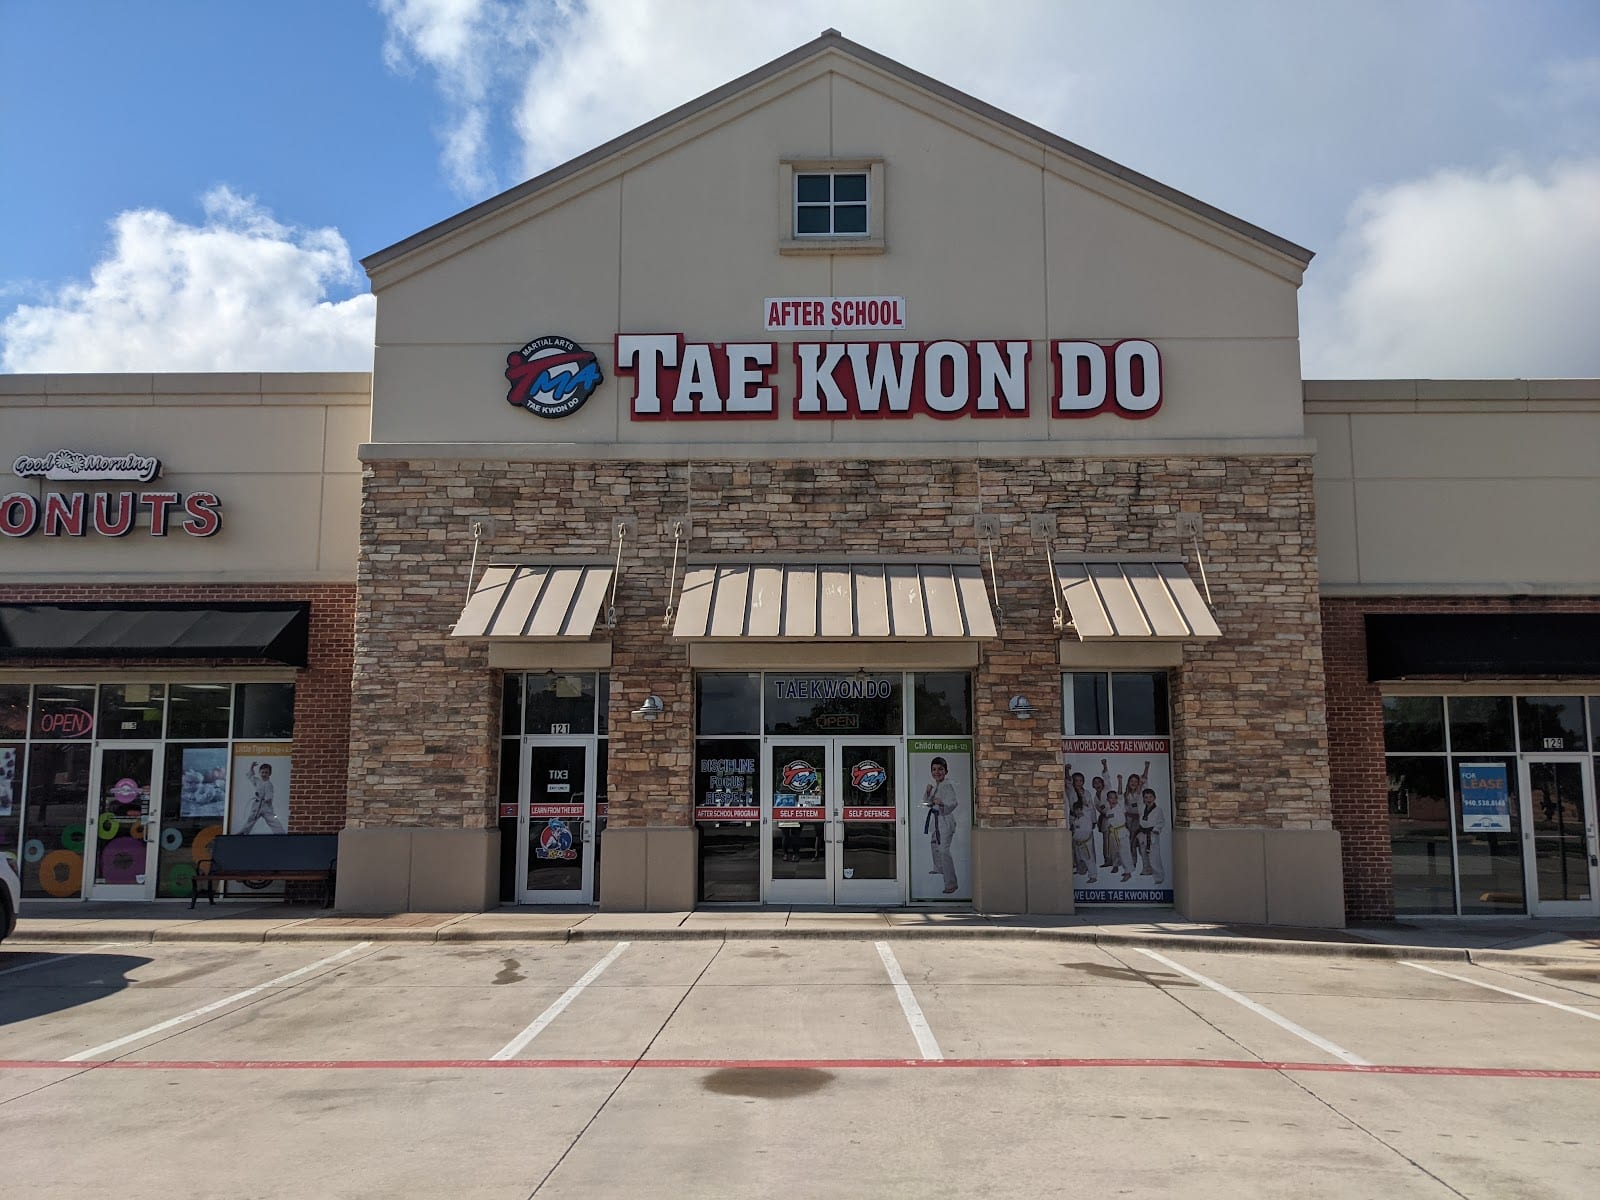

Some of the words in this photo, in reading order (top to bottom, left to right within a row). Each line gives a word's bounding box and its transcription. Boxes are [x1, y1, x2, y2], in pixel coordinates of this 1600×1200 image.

[768, 301, 825, 327] AFTER
[831, 300, 903, 326] SCHOOL
[522, 339, 554, 357] MARTIAL
[554, 339, 575, 351] ARTS
[616, 334, 775, 414] TAE
[796, 340, 1030, 414] KWON
[1056, 339, 1161, 413] DO
[527, 399, 542, 411] TAE
[541, 404, 569, 414] KWON
[567, 397, 580, 408] DO
[15, 456, 54, 473] Good
[83, 453, 155, 477] Morning
[41, 713, 86, 732] OPEN
[818, 715, 857, 728] OPEN
[552, 724, 570, 734] 121
[915, 742, 943, 750] Children
[1073, 741, 1097, 751] WORLD
[1097, 741, 1119, 751] CLASS
[1544, 738, 1563, 748] 129
[701, 758, 756, 773] DISCIPLINE
[710, 775, 745, 789] FOCUS
[1463, 779, 1504, 789] LEASE
[705, 791, 753, 806] RESPECT
[531, 806, 547, 815] LEARN
[547, 806, 561, 815] FROM
[561, 806, 570, 814] THE
[570, 806, 583, 814] BEST
[1085, 890, 1106, 900] LOVE
